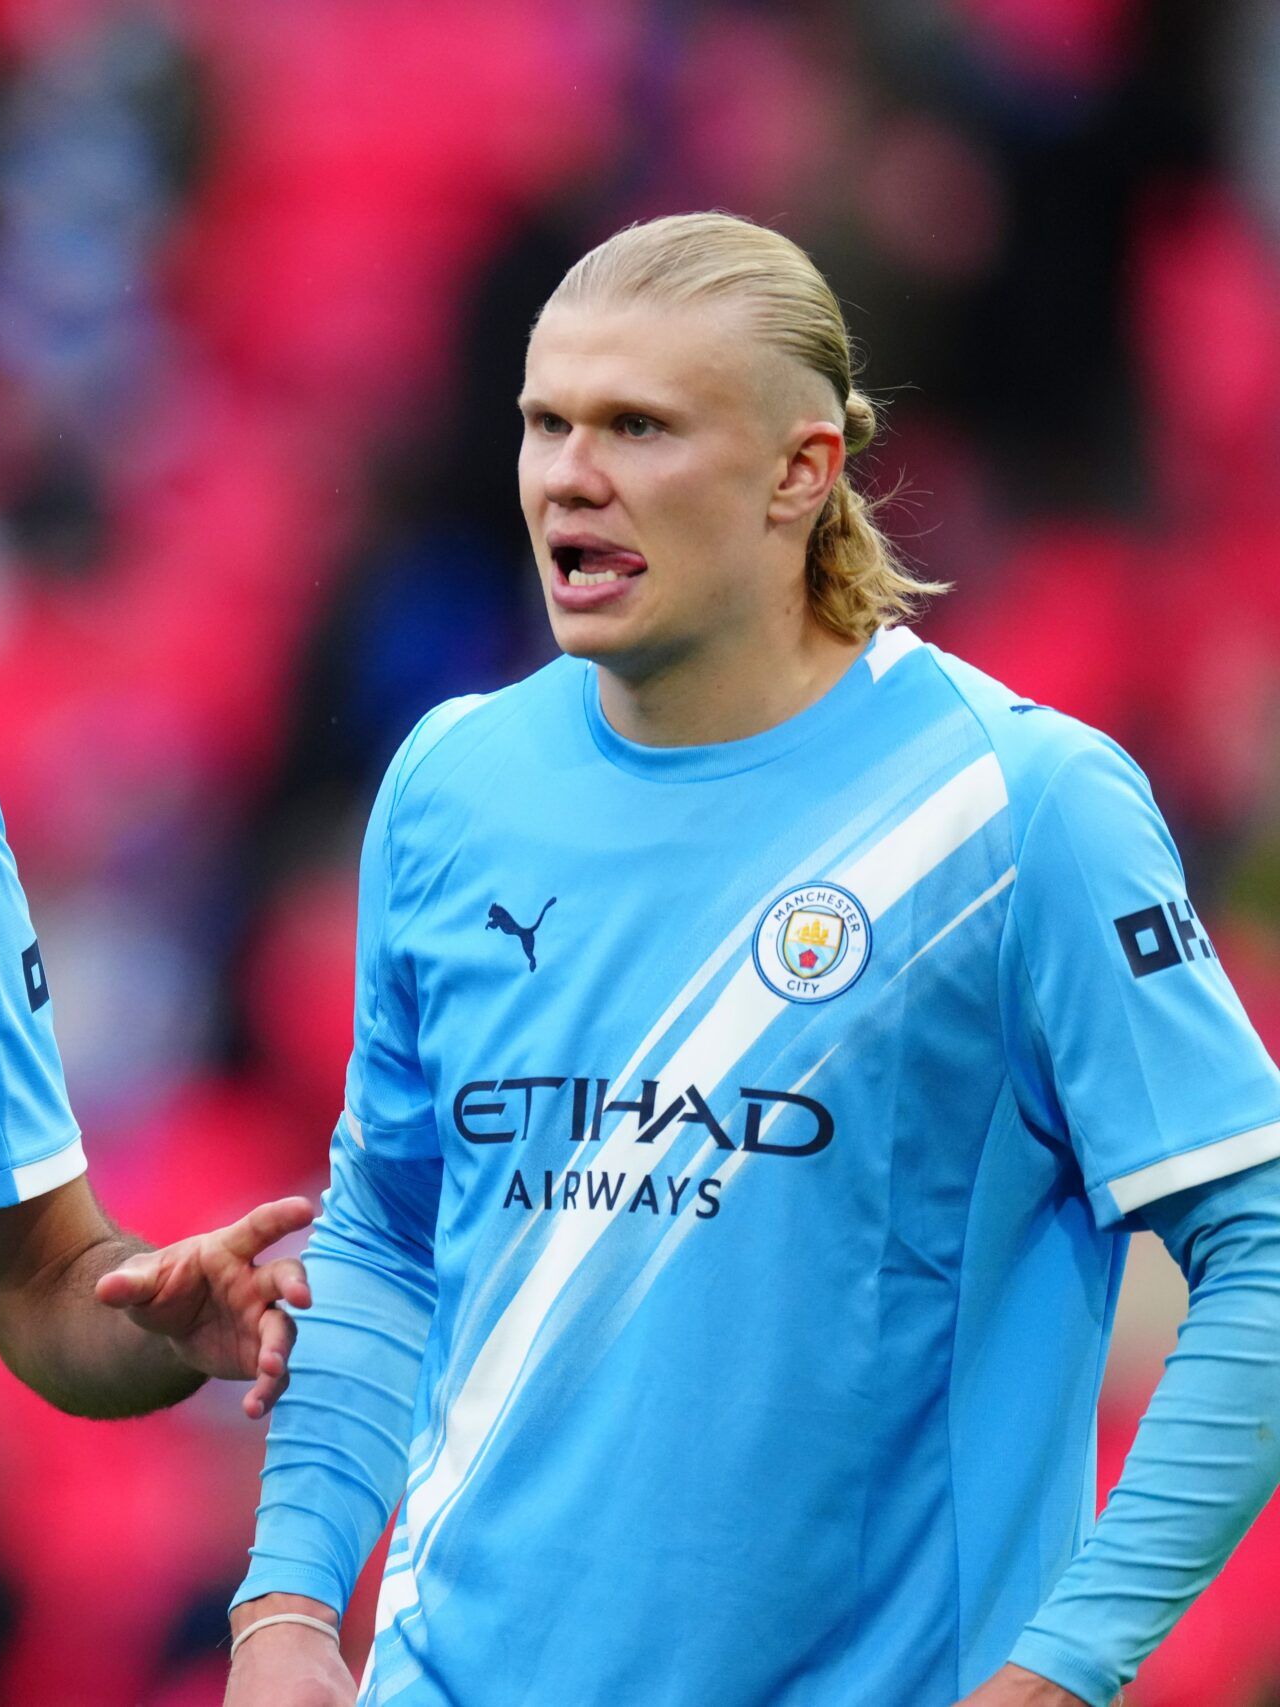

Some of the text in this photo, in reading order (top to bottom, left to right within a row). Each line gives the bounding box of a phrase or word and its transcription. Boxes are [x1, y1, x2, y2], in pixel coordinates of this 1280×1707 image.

[774, 892, 860, 932] MANCHESTER
[786, 979, 820, 994] CITY
[453, 1077, 834, 1157] ETIHAD
[503, 1169, 721, 1219] AIRWAYS
